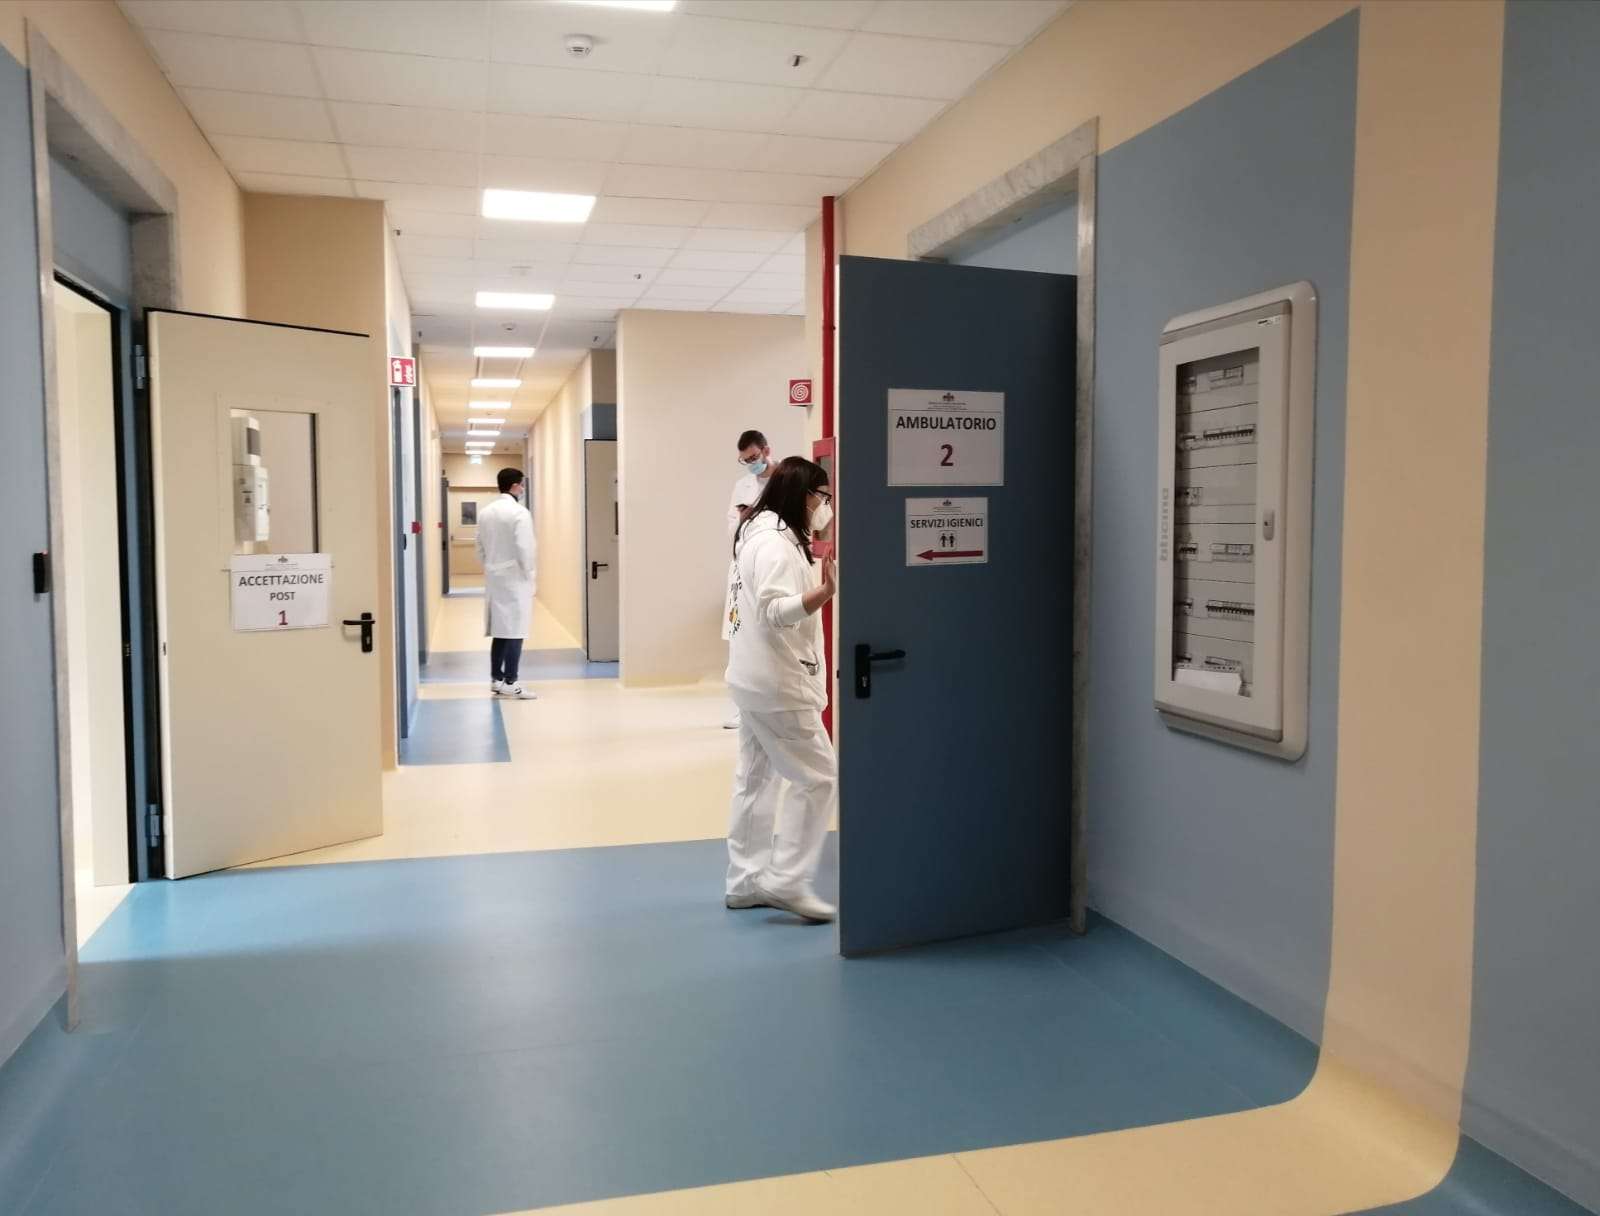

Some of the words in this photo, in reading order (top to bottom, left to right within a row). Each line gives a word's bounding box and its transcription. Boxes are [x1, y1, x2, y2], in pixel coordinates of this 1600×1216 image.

[896, 416, 997, 430] AMBULATORIO
[940, 443, 954, 467] 2
[910, 519, 945, 529] SERVIZI
[947, 518, 984, 528] IGIENICI
[238, 573, 324, 587] ACCETTAZIONE
[269, 591, 296, 601] POST
[278, 609, 288, 626] 1
